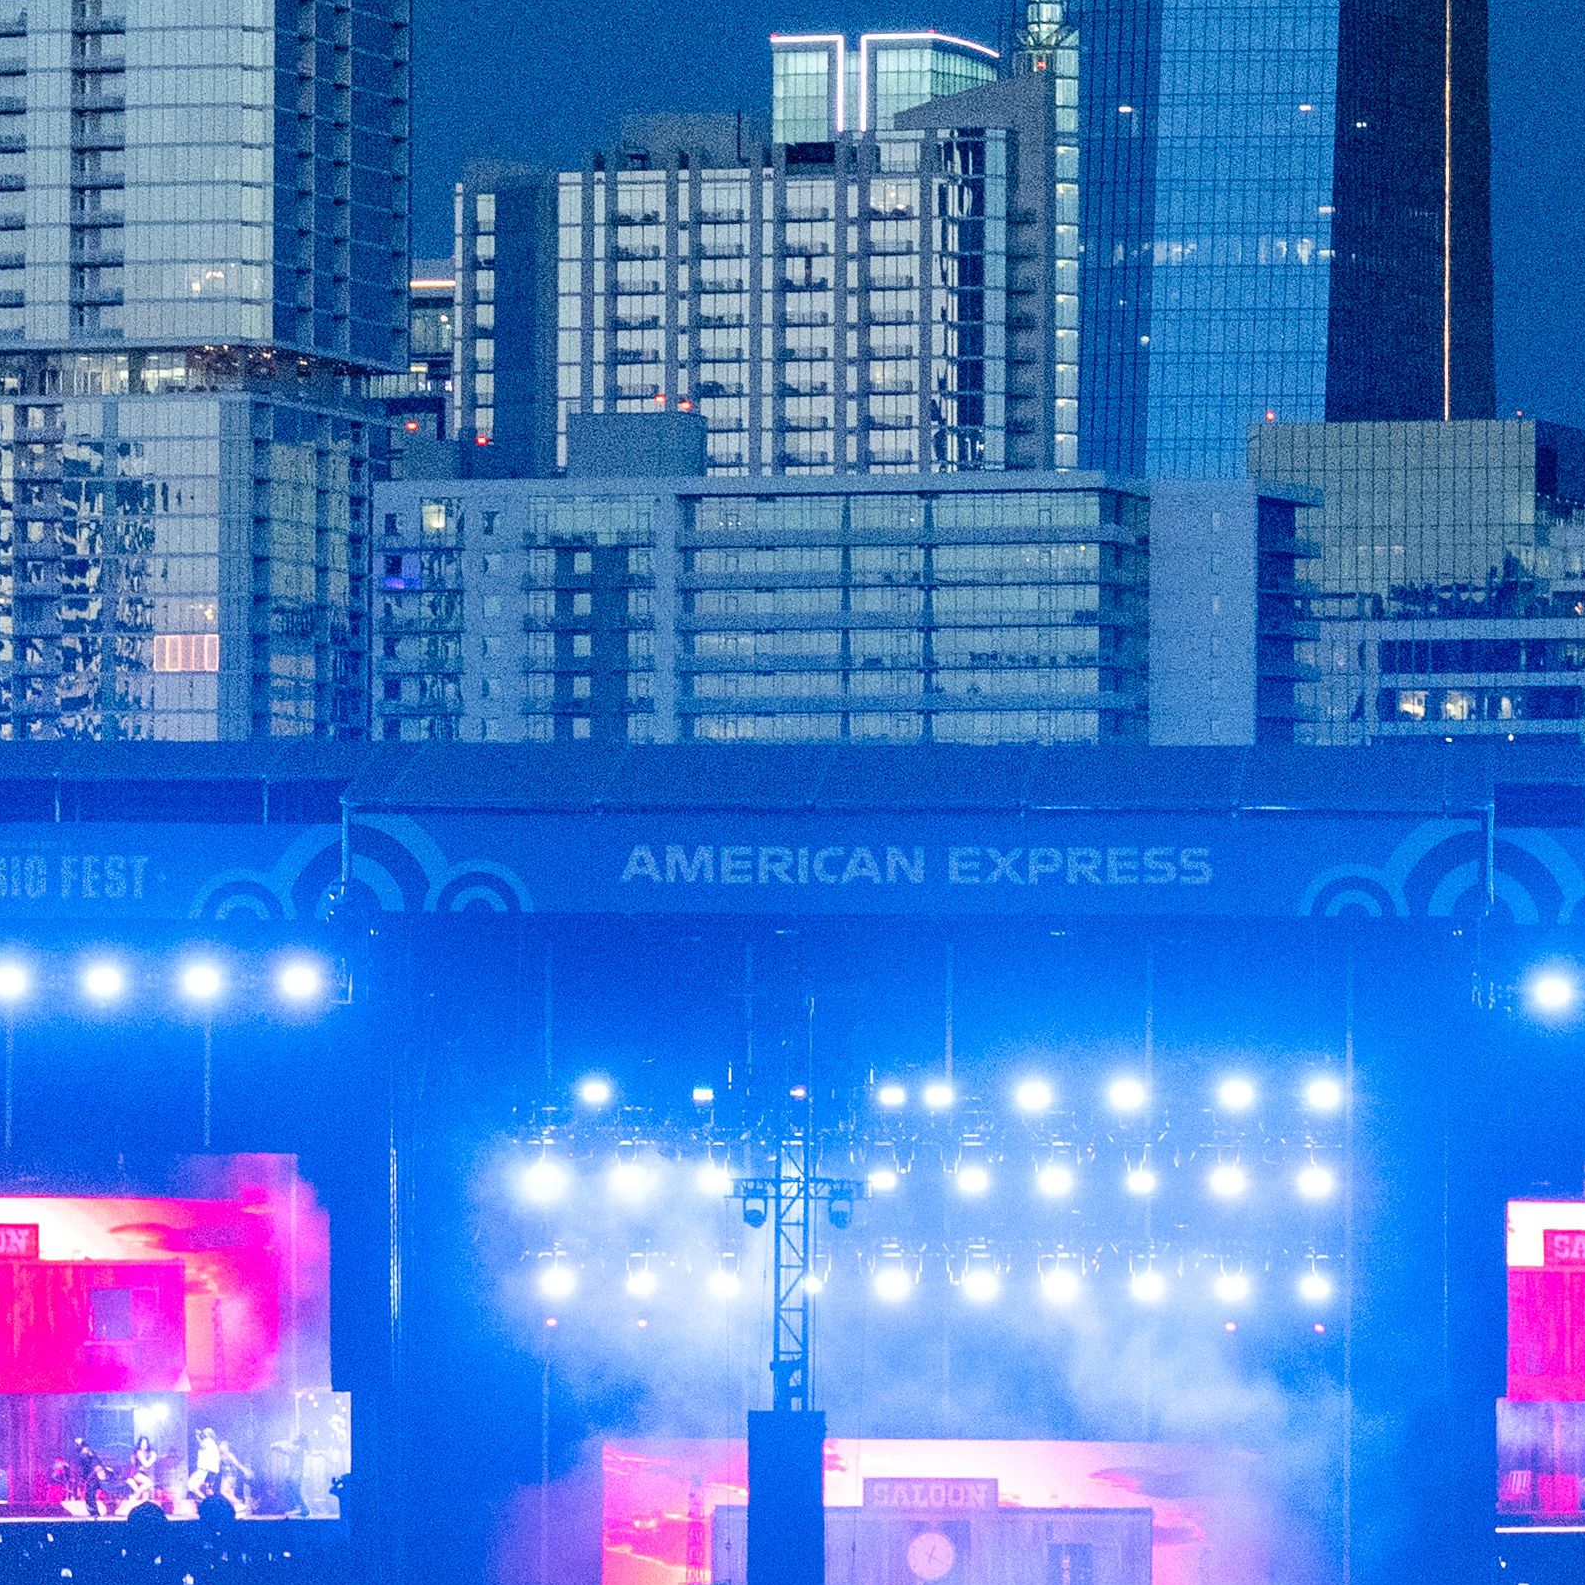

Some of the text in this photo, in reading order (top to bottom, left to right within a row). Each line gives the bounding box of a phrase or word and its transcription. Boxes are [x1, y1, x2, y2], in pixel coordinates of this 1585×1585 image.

[60, 854, 149, 899] FEST
[620, 844, 1211, 885] AMERICAN EXPRESS
[874, 1482, 989, 1508] SALOON
